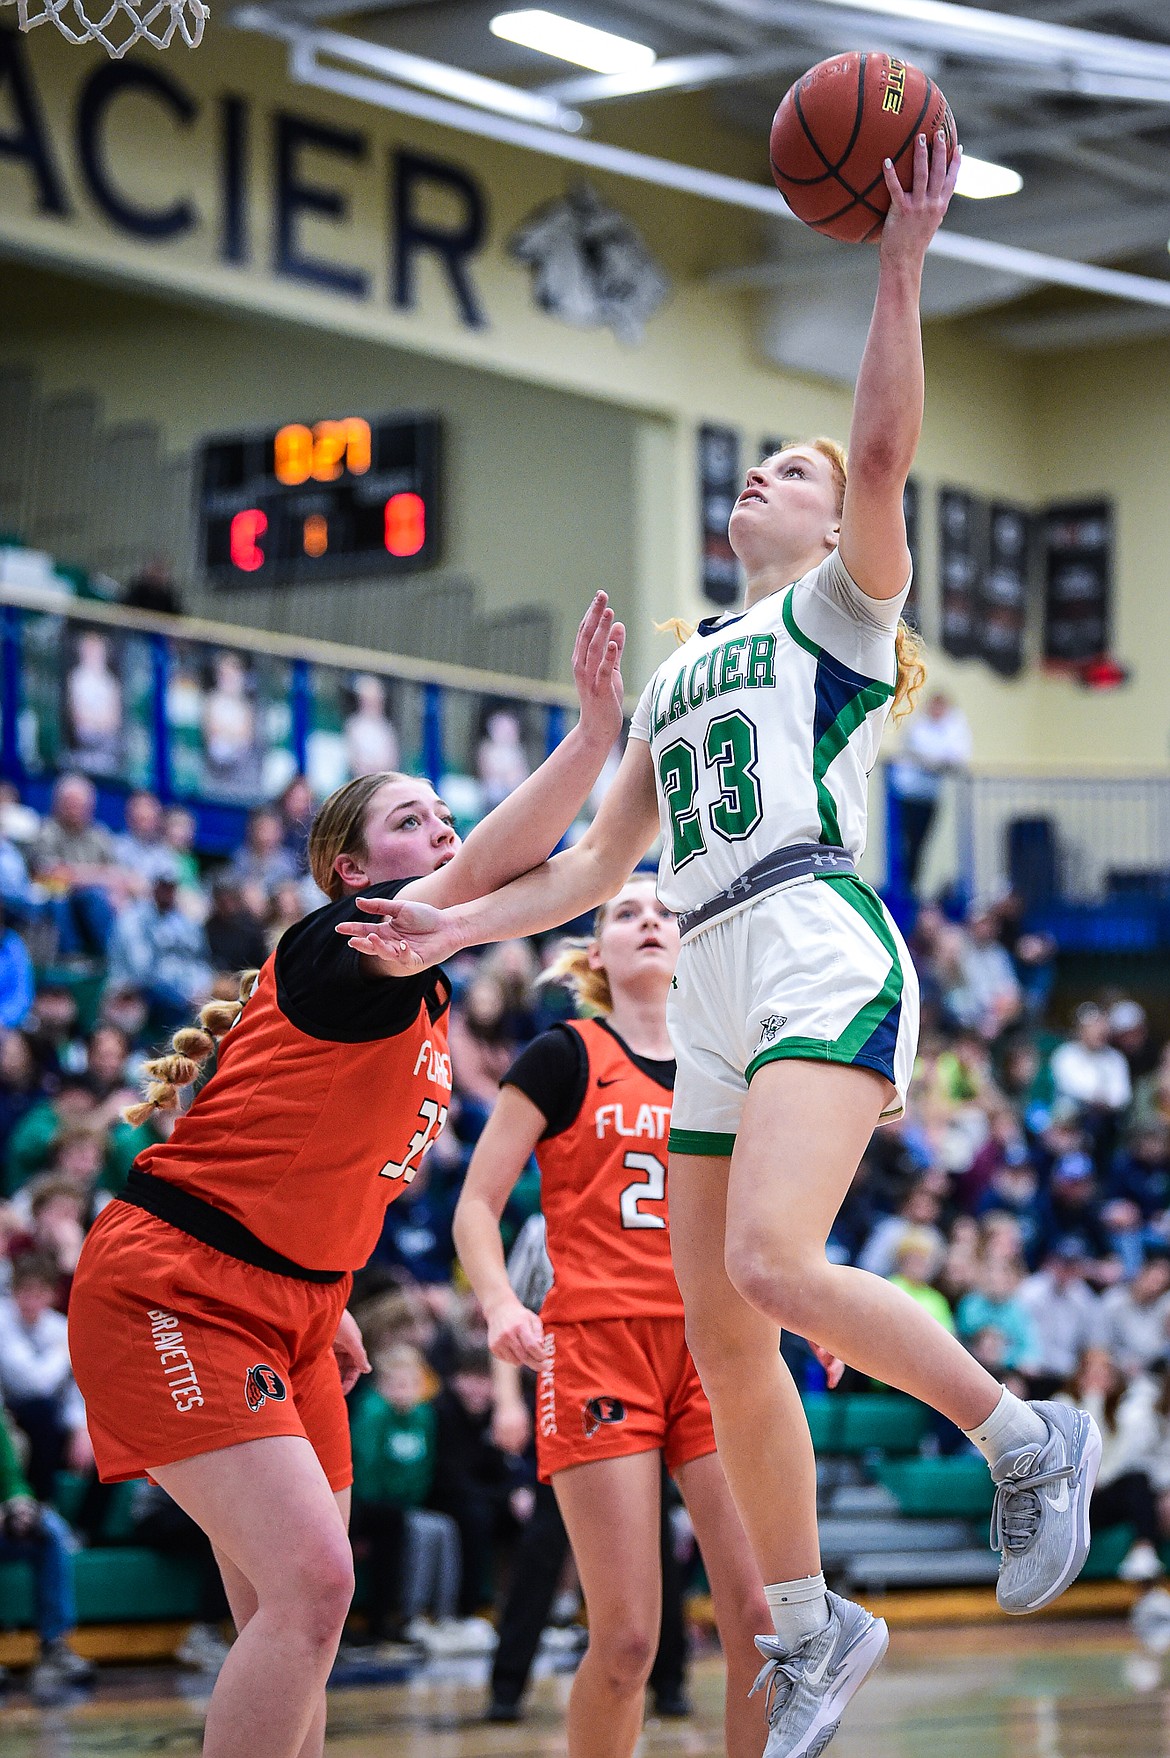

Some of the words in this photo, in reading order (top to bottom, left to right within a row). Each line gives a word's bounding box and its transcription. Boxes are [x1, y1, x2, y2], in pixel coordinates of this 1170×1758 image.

[649, 632, 777, 743] LACIER
[658, 708, 763, 875] 23
[620, 1151, 666, 1229] 2
[147, 1309, 204, 1412] BRAVETTES
